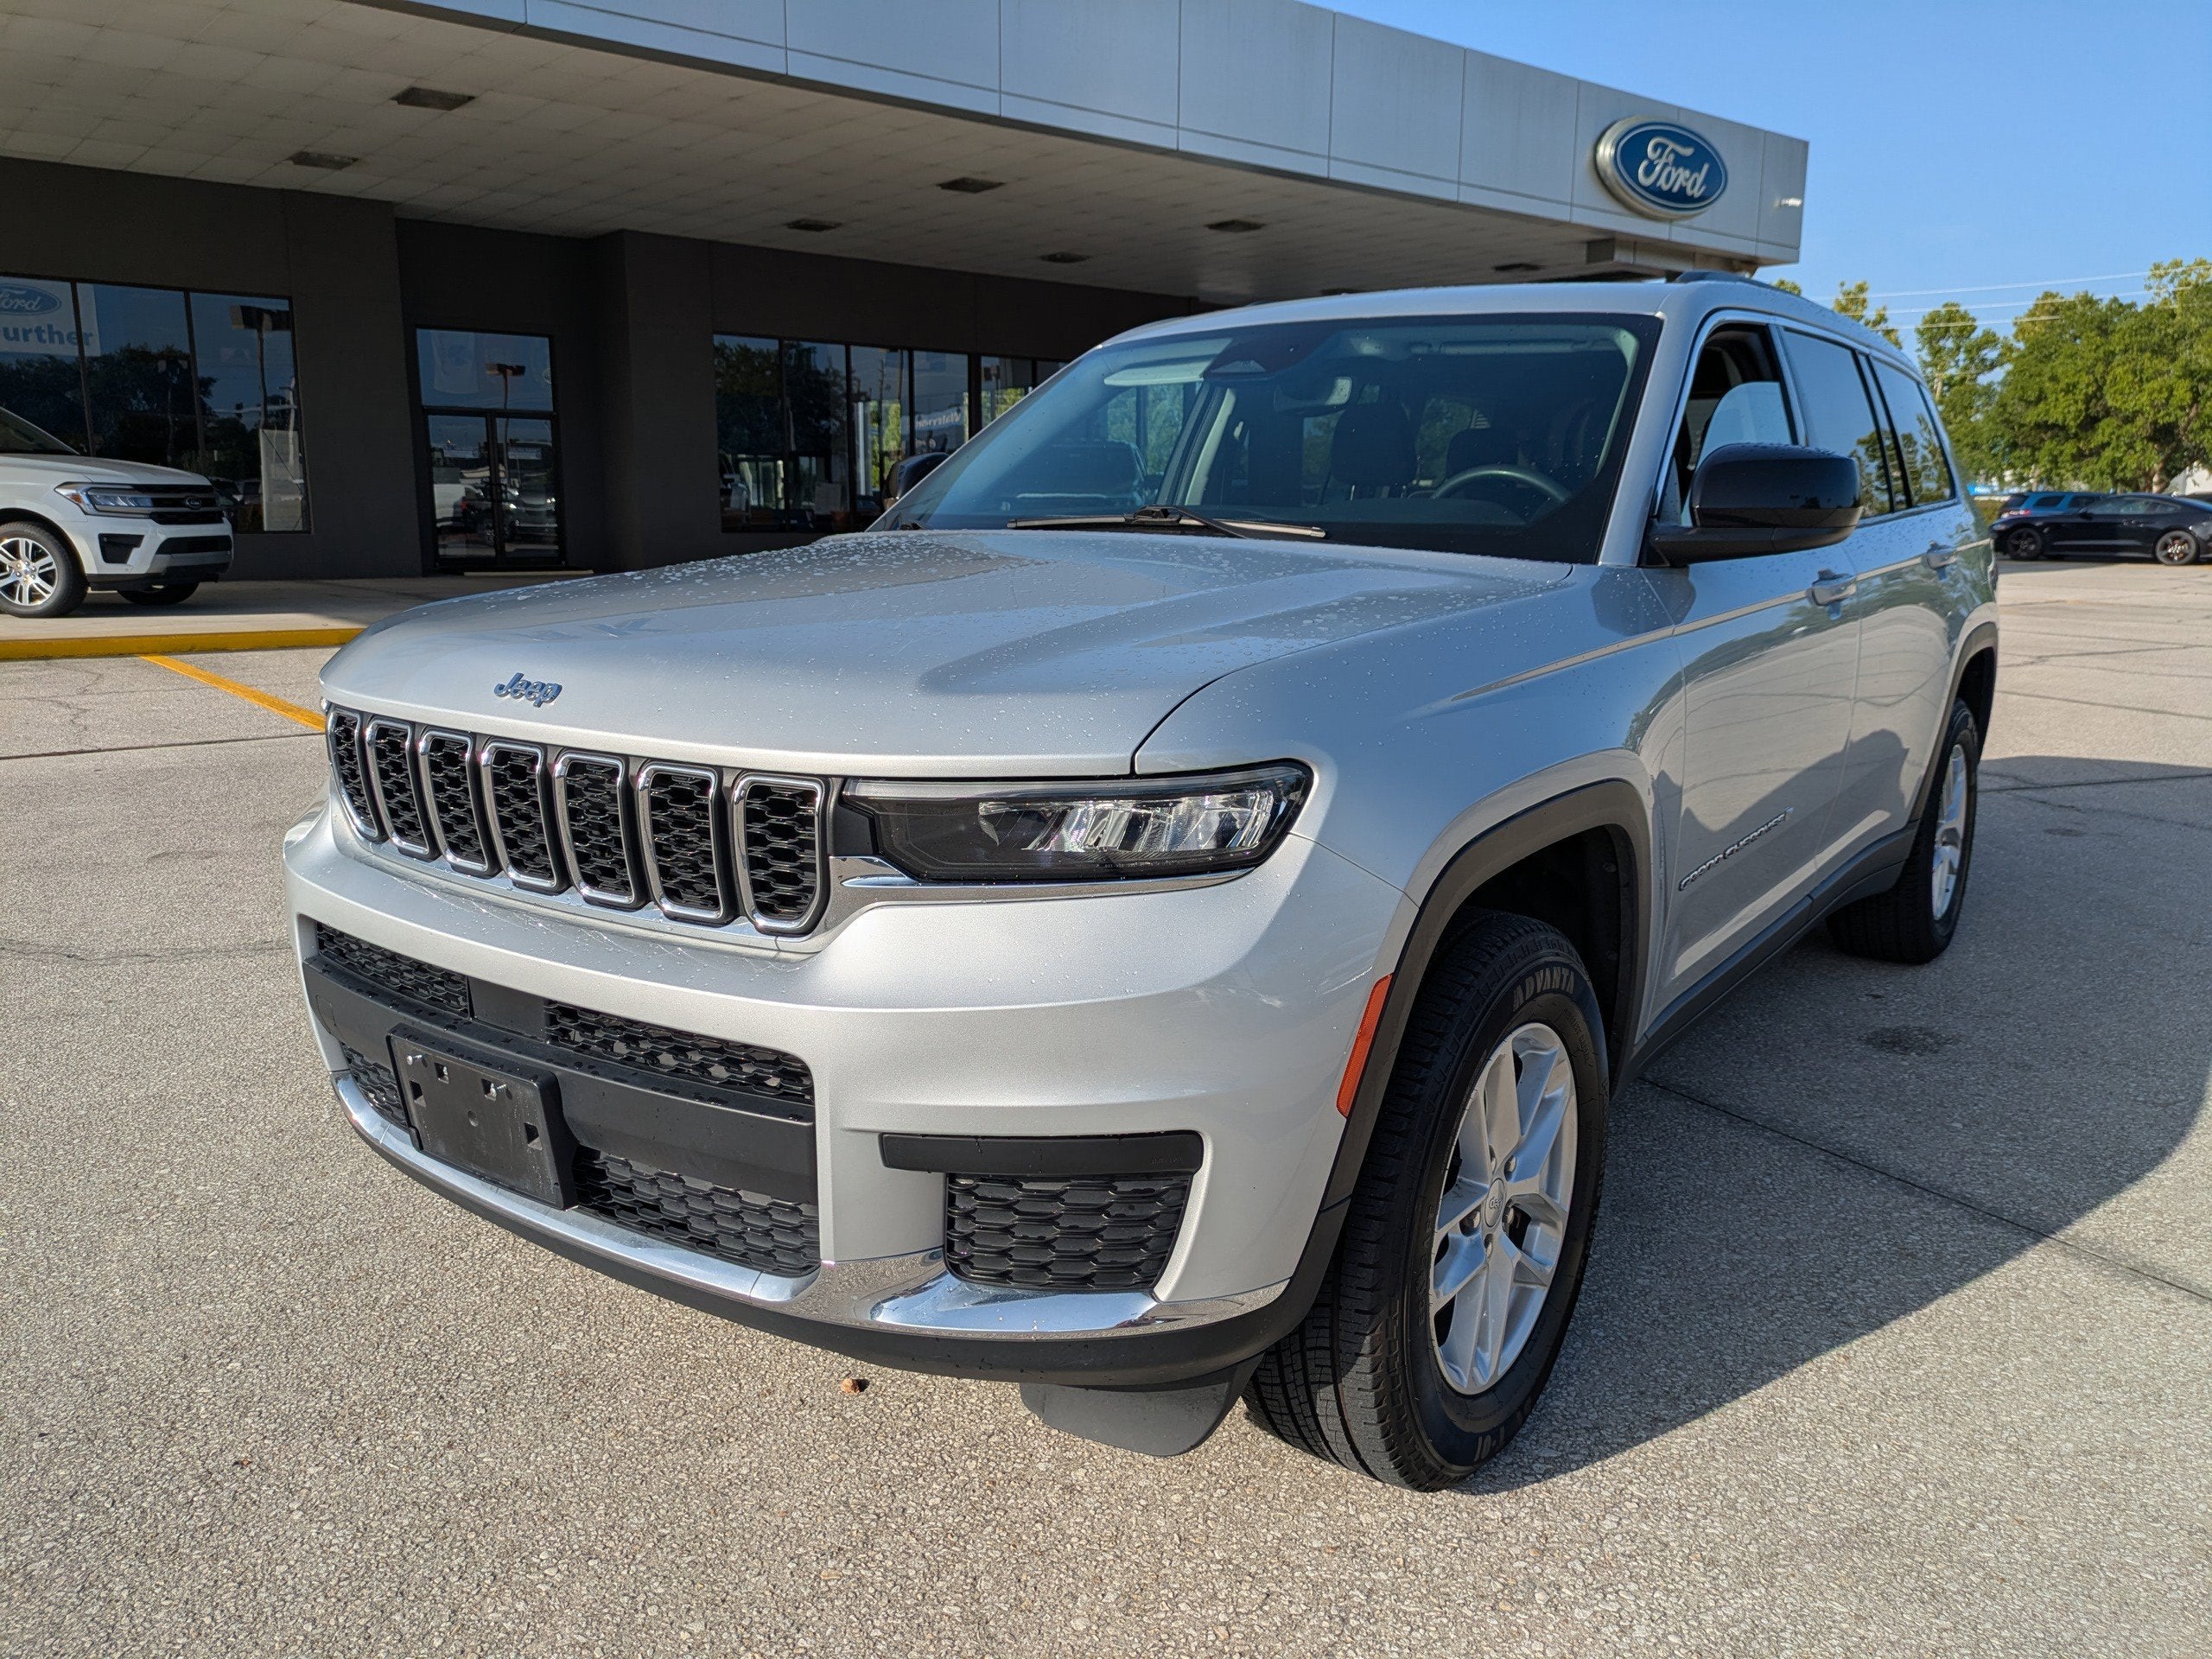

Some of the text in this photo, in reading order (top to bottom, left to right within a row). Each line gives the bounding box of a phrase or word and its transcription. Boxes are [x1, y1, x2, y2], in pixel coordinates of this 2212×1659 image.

[1638, 137, 1710, 199] Ford
[493, 672, 563, 708] Jeep
[1513, 966, 1574, 1011] ADVANTA
